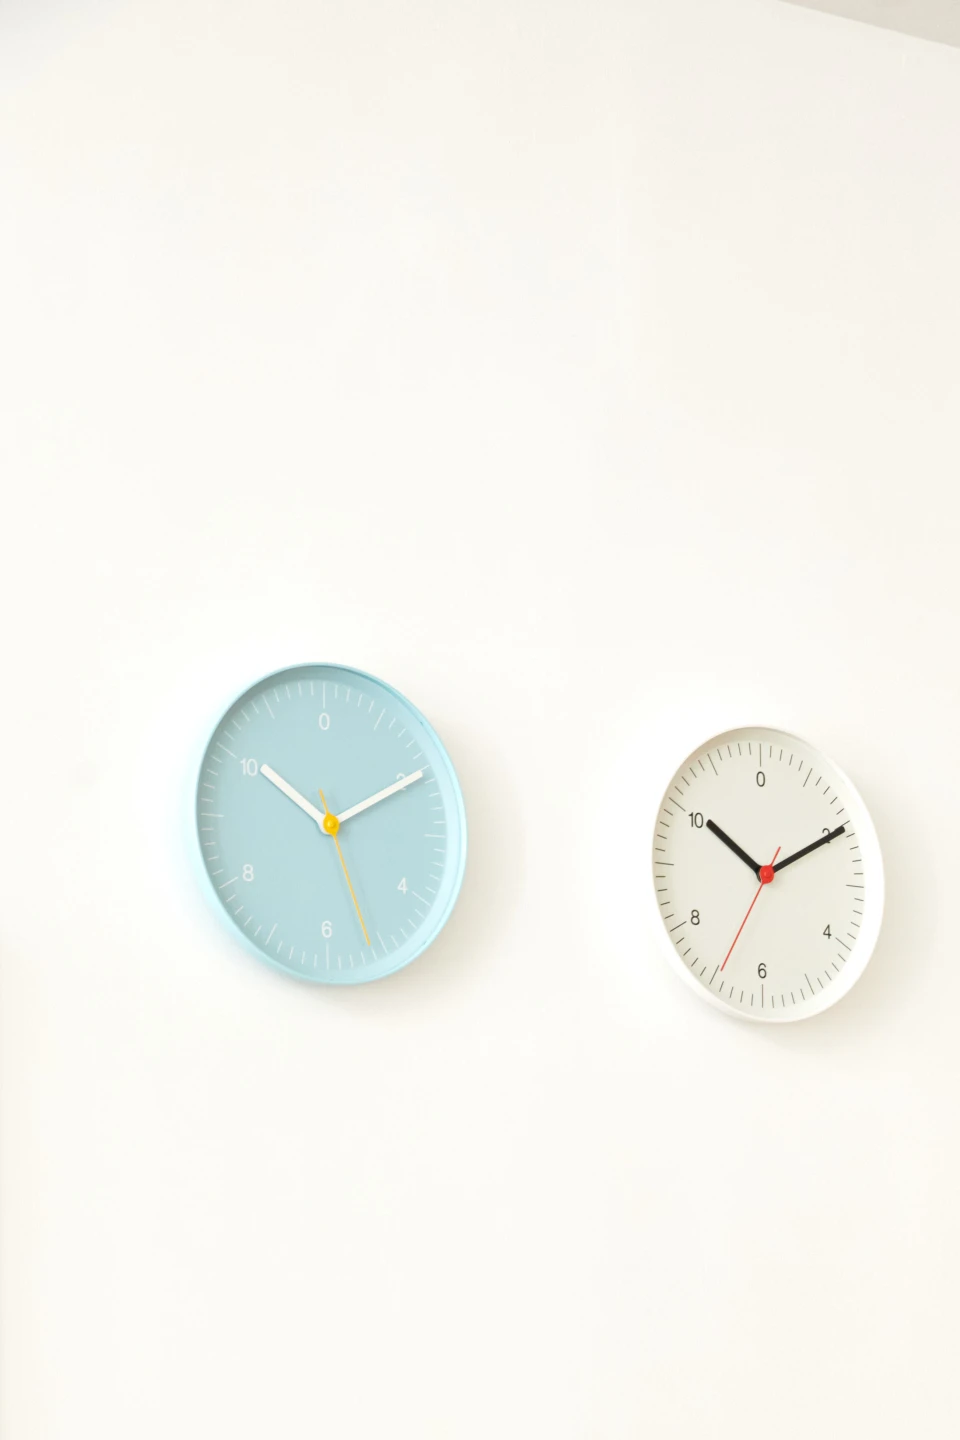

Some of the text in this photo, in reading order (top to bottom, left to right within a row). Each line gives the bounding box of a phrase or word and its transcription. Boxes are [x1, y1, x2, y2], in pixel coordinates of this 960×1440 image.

[318, 712, 330, 731] 0
[239, 757, 259, 777] 10
[756, 770, 766, 788] 0
[688, 811, 704, 829] 10
[242, 863, 255, 882] 8
[397, 877, 410, 894] 4
[690, 909, 701, 926] 8
[321, 920, 333, 939] 6
[822, 924, 832, 939] 4
[757, 962, 767, 979] 6
